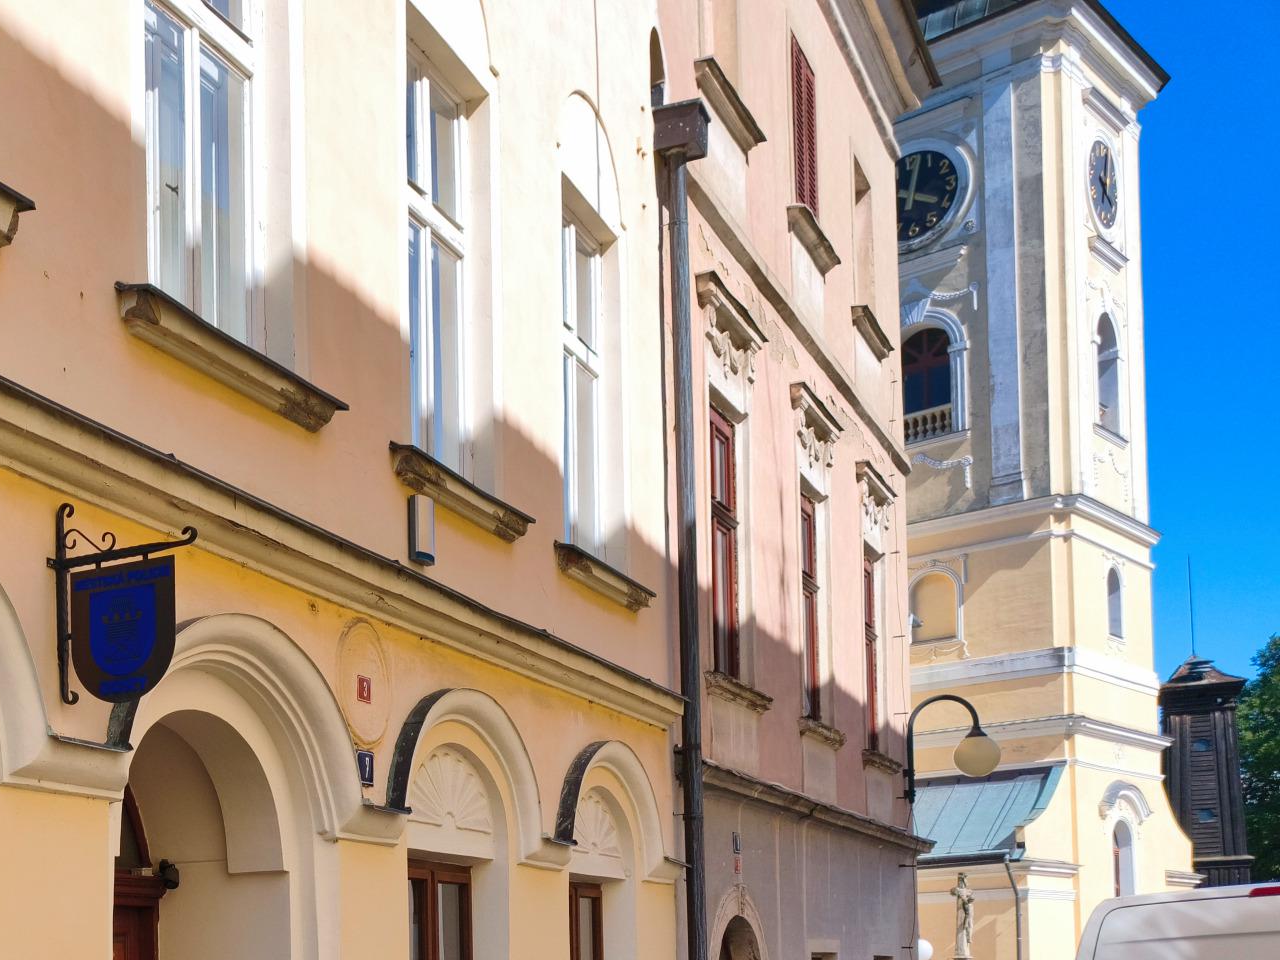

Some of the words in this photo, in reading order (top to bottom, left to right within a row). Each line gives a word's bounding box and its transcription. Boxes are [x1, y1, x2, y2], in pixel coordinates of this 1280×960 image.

[939, 159, 950, 174] 2
[945, 175, 956, 191] 3
[941, 194, 951, 208] 4
[925, 211, 937, 227] 5
[908, 222, 919, 237] 6
